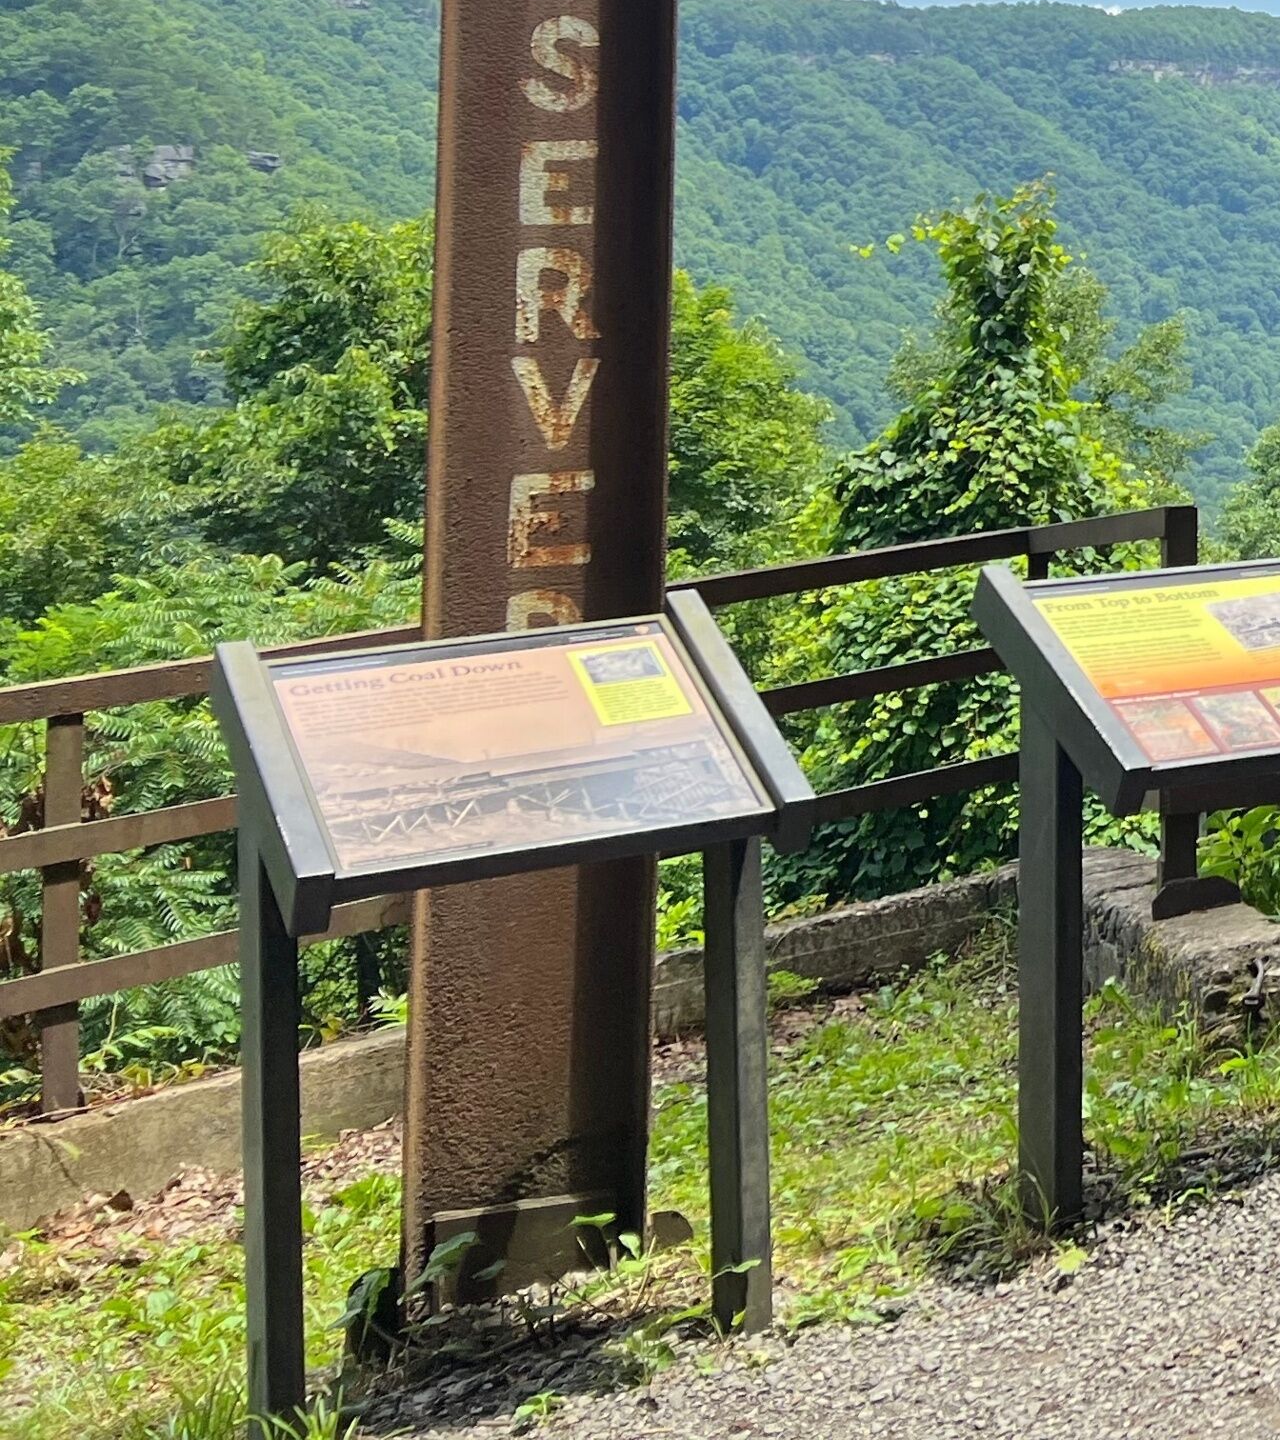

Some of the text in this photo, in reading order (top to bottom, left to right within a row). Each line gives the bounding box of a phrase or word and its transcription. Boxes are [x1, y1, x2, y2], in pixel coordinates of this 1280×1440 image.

[1042, 588, 1220, 614] From Top to Bottom
[289, 675, 386, 698] Getting
[388, 668, 444, 685] Coal
[449, 659, 523, 677] Down
